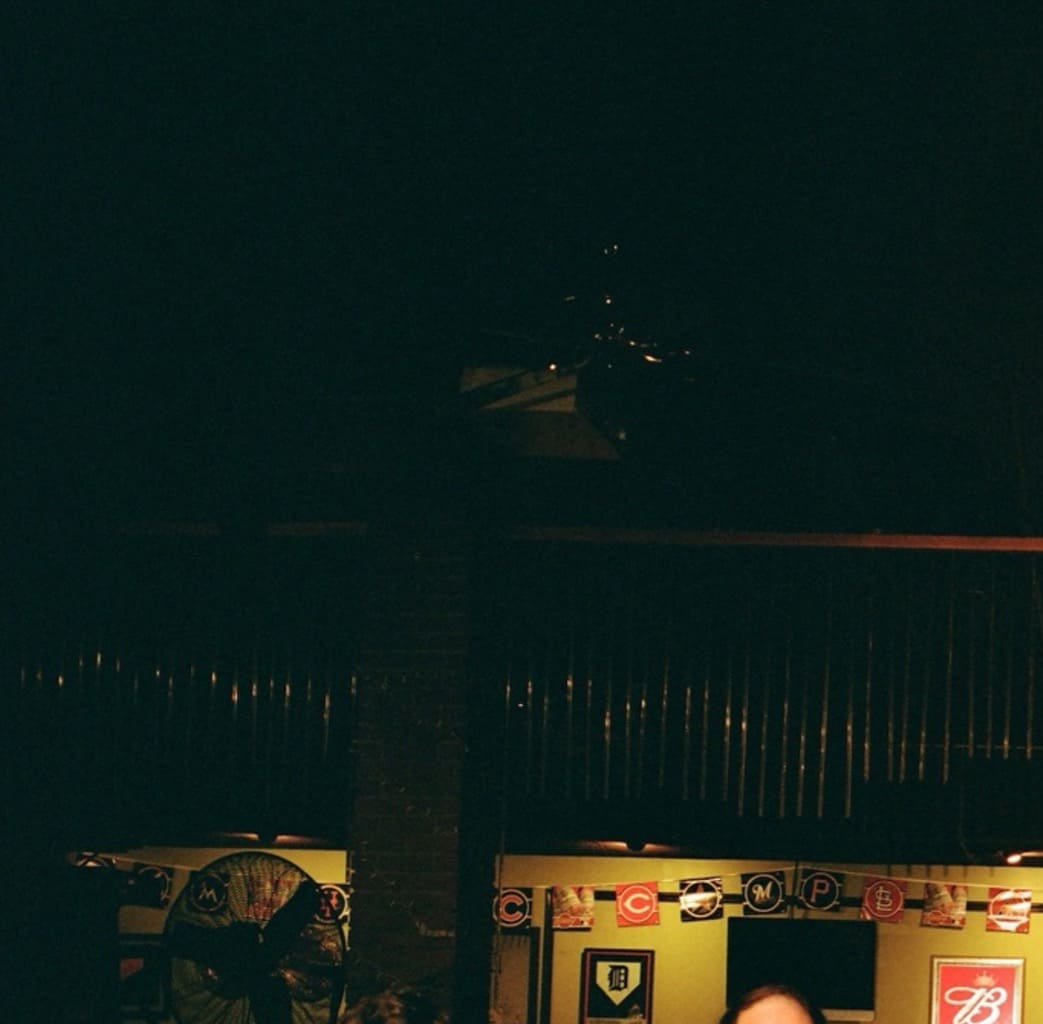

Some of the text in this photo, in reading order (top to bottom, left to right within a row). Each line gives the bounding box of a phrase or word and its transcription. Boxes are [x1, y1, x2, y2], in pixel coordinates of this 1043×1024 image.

[752, 881, 772, 902] M
[811, 879, 830, 903] P
[500, 893, 524, 922] C
[624, 893, 652, 914] C
[607, 965, 629, 991] D
